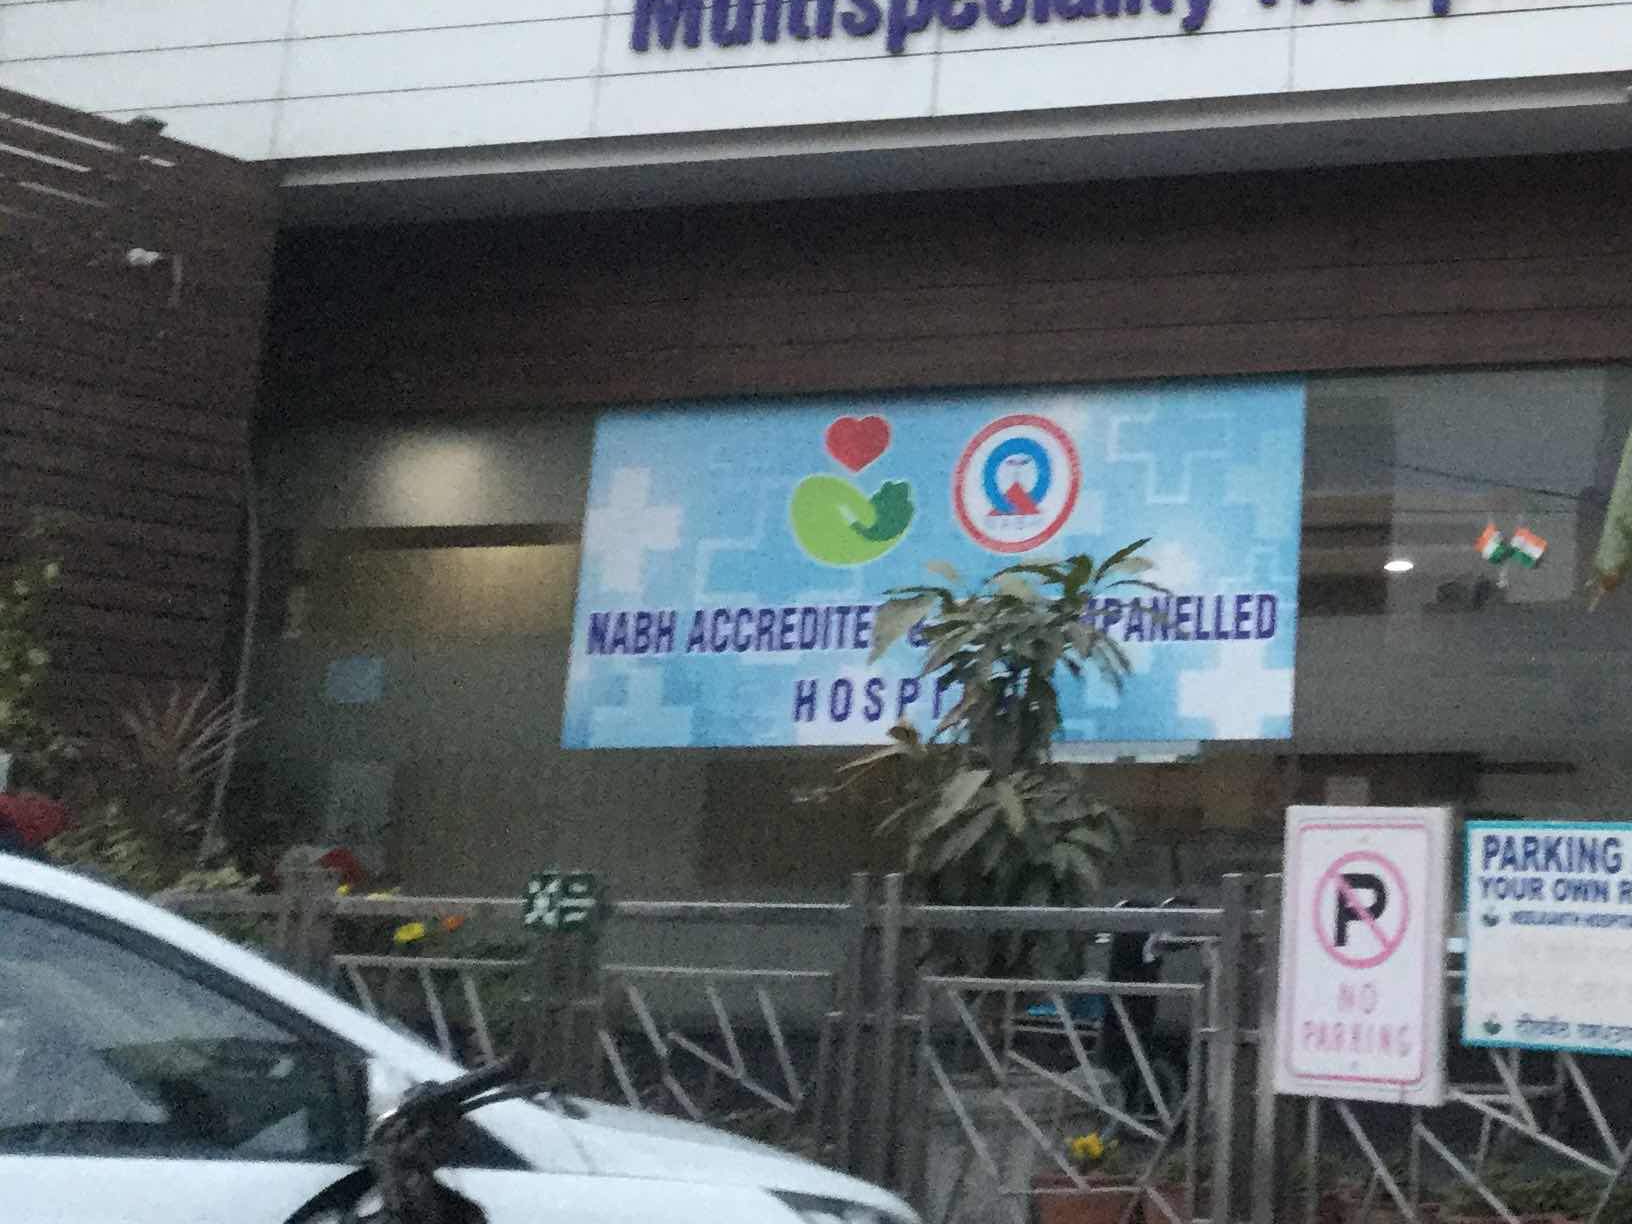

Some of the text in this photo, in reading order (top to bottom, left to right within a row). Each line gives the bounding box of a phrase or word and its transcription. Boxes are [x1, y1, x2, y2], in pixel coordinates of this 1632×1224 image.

[587, 609, 677, 655] NABH
[686, 604, 875, 654] ACCREDITE
[1079, 594, 1279, 643] PANELLED
[1482, 834, 1624, 875] PARKING
[1480, 876, 1544, 901] YOUR
[1554, 878, 1610, 904] OWN
[1338, 982, 1379, 1015] NO
